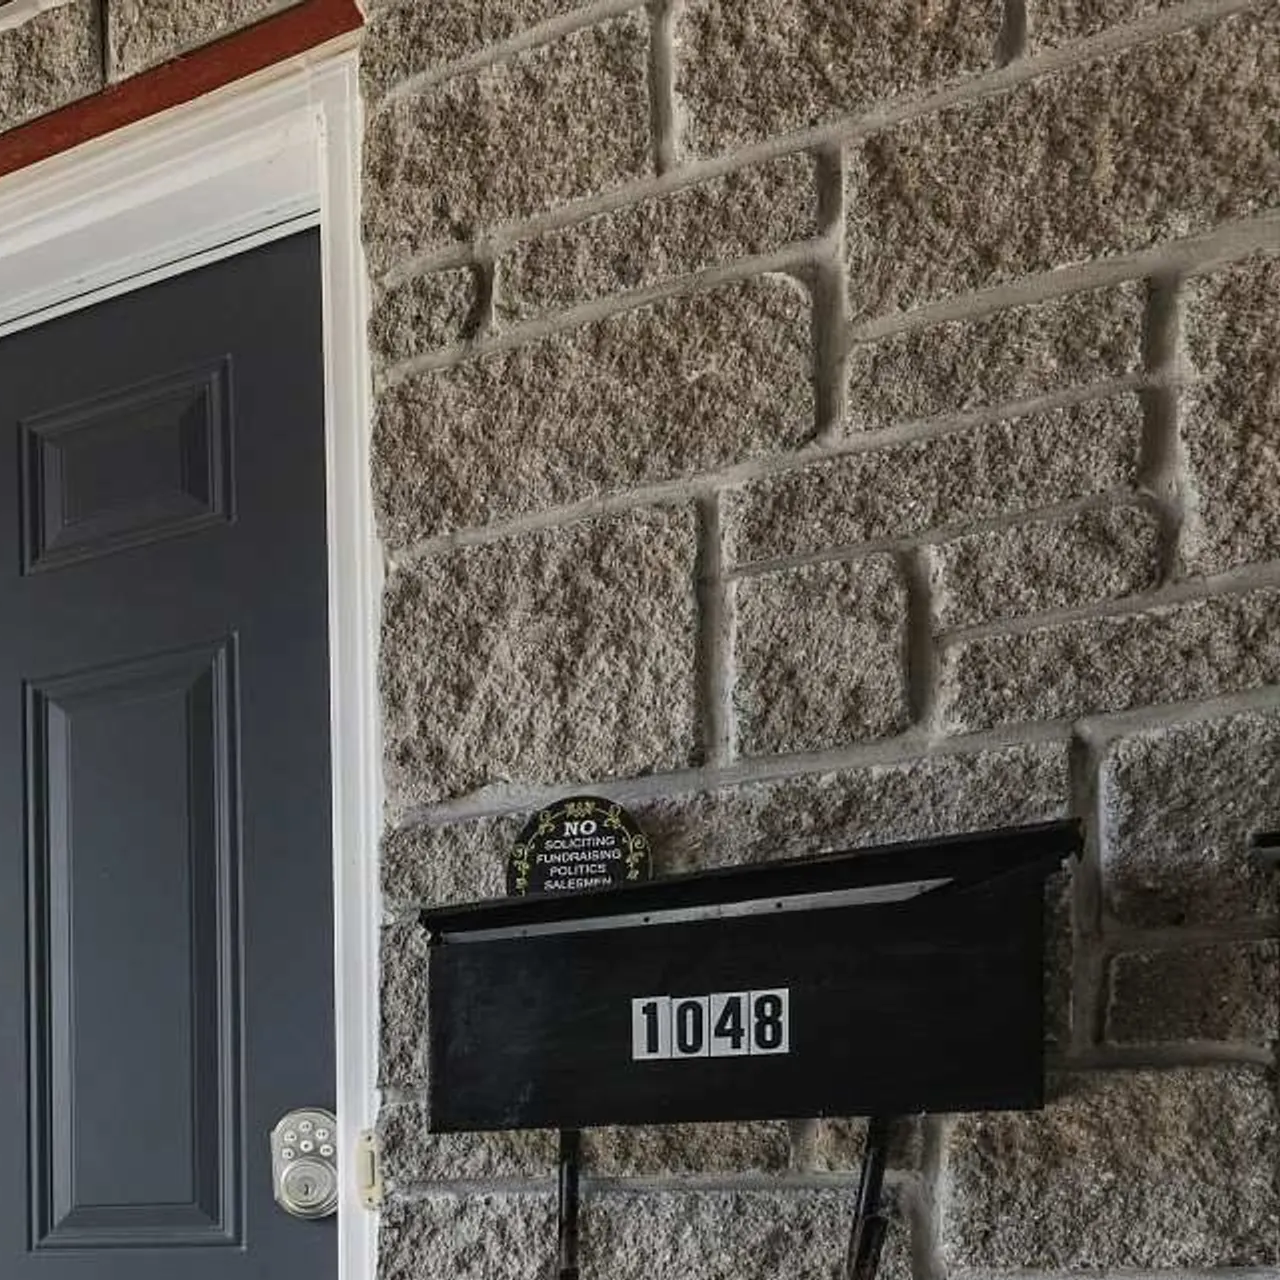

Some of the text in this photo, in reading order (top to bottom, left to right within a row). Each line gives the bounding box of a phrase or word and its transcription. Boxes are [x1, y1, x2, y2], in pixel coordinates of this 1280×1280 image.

[563, 820, 597, 836] NO
[544, 836, 615, 850] SOLICITING
[536, 848, 621, 864] FUNDRAISING
[549, 863, 606, 877] POLITICS
[642, 994, 783, 1054] 1048
